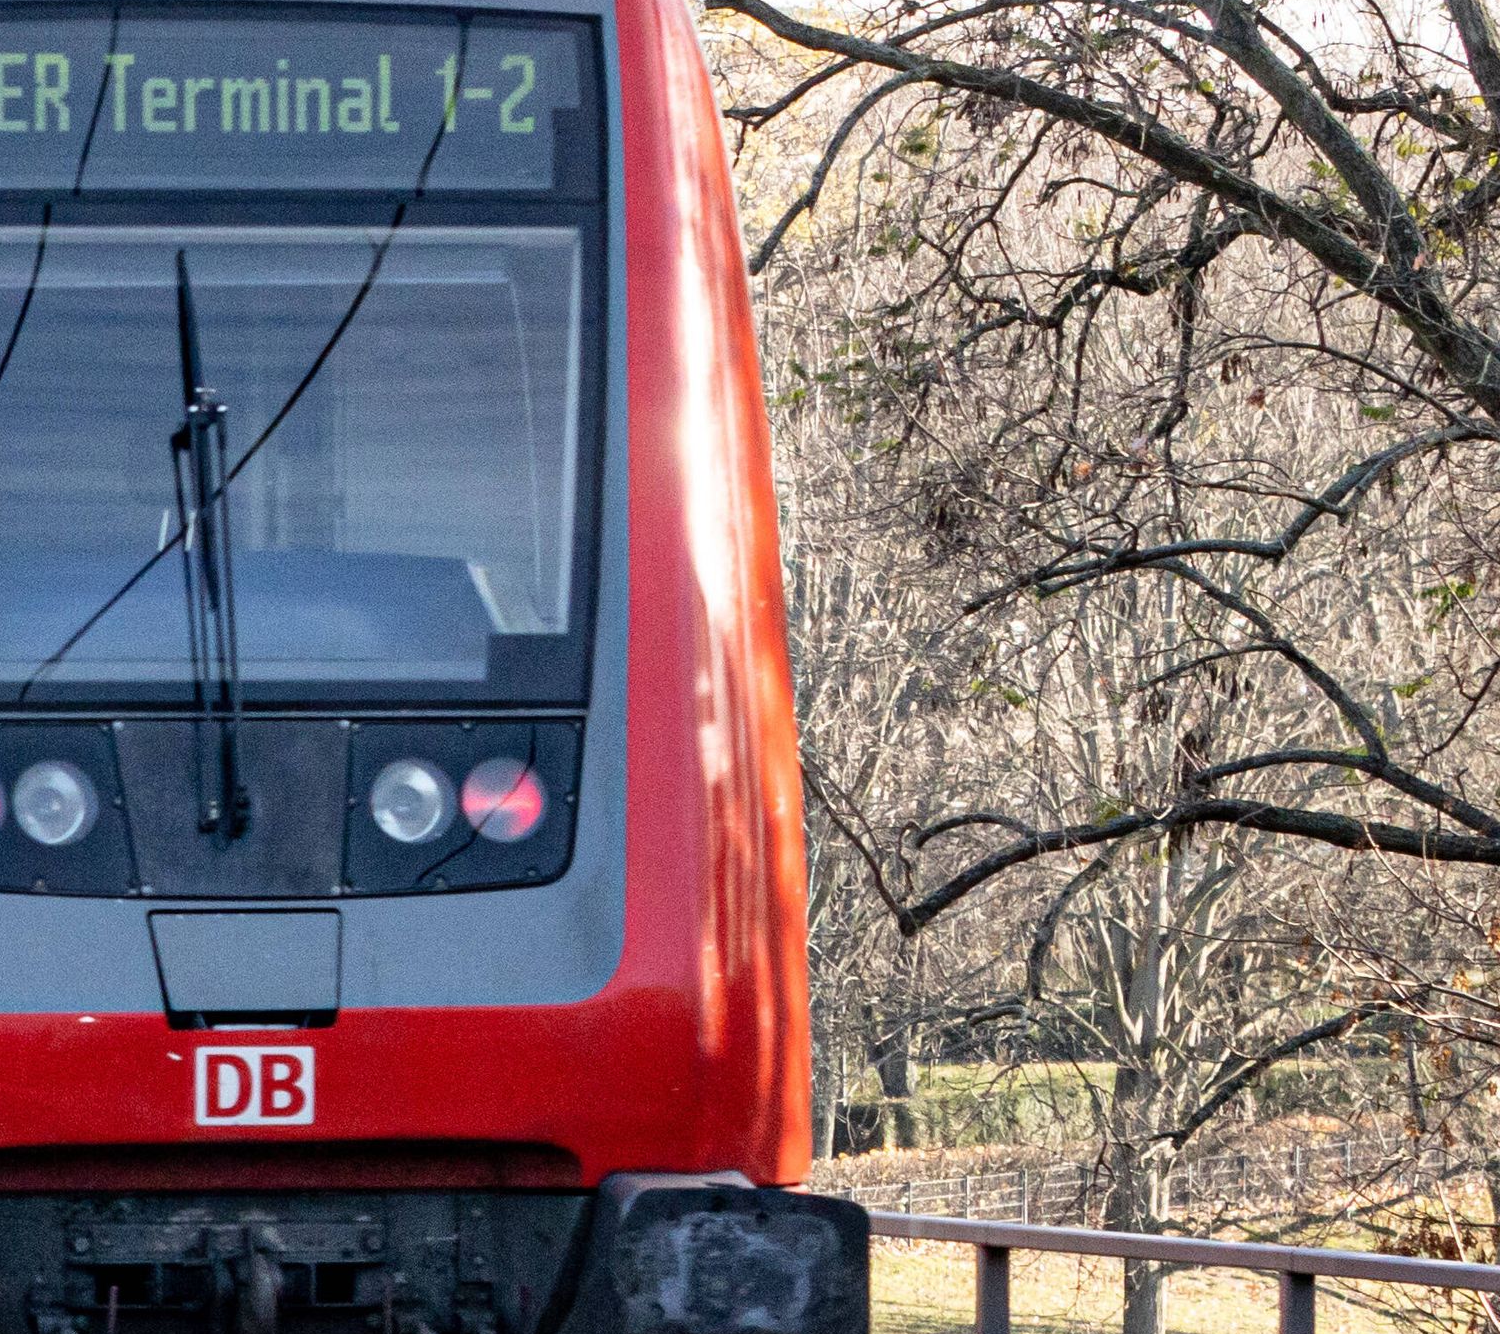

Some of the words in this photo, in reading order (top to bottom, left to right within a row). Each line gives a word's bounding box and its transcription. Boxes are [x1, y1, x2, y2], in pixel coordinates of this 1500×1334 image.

[102, 51, 402, 133] Terminal
[431, 53, 539, 133] 1-2
[205, 1053, 307, 1118] DB
